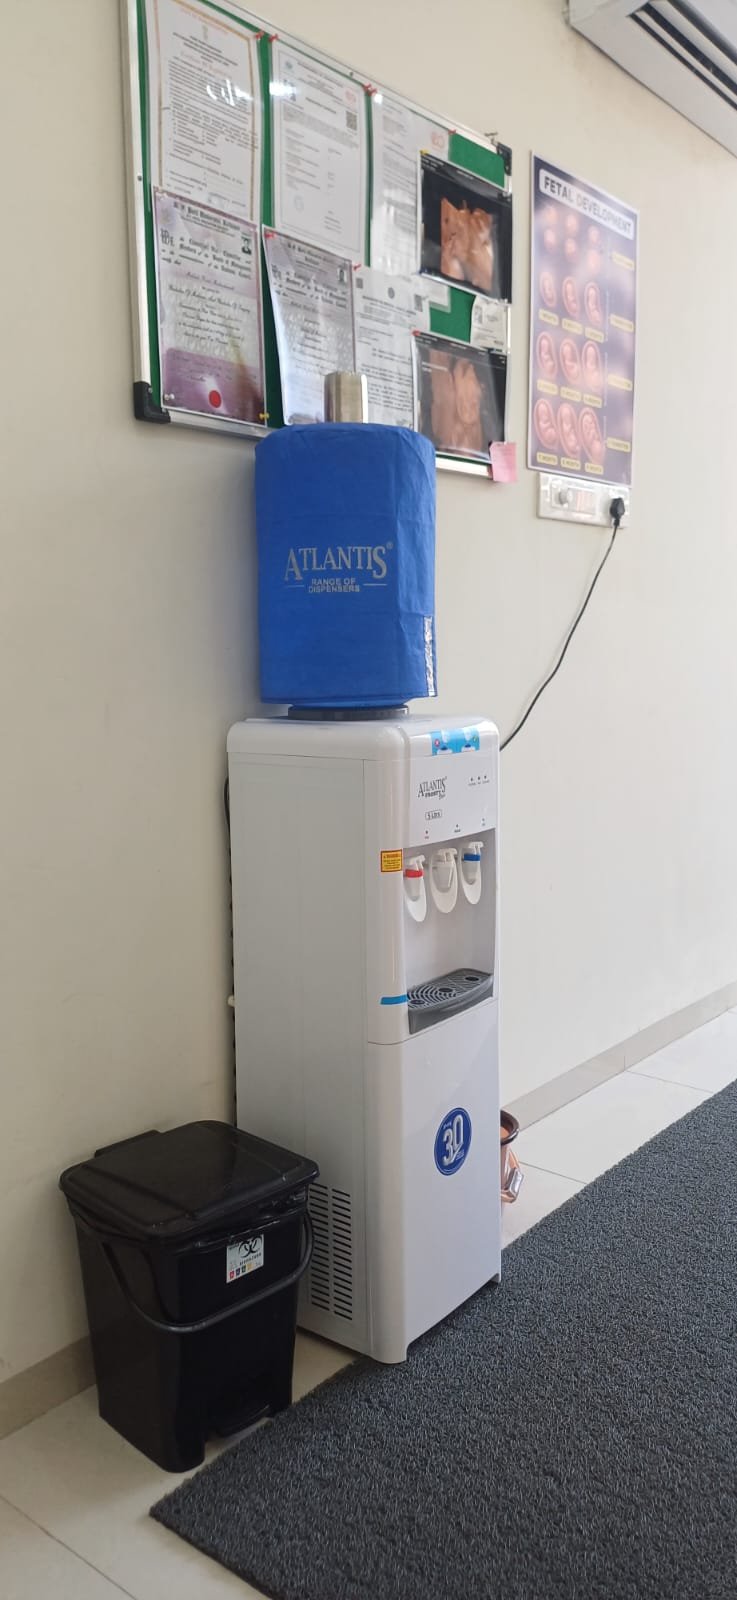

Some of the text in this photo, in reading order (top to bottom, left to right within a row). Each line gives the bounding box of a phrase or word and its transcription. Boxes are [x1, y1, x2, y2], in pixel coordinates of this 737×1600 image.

[544, 175, 631, 234] FETAL DEVELOPMENT
[311, 577, 356, 586] RANGE OF
[308, 584, 360, 593] DISPENSERS
